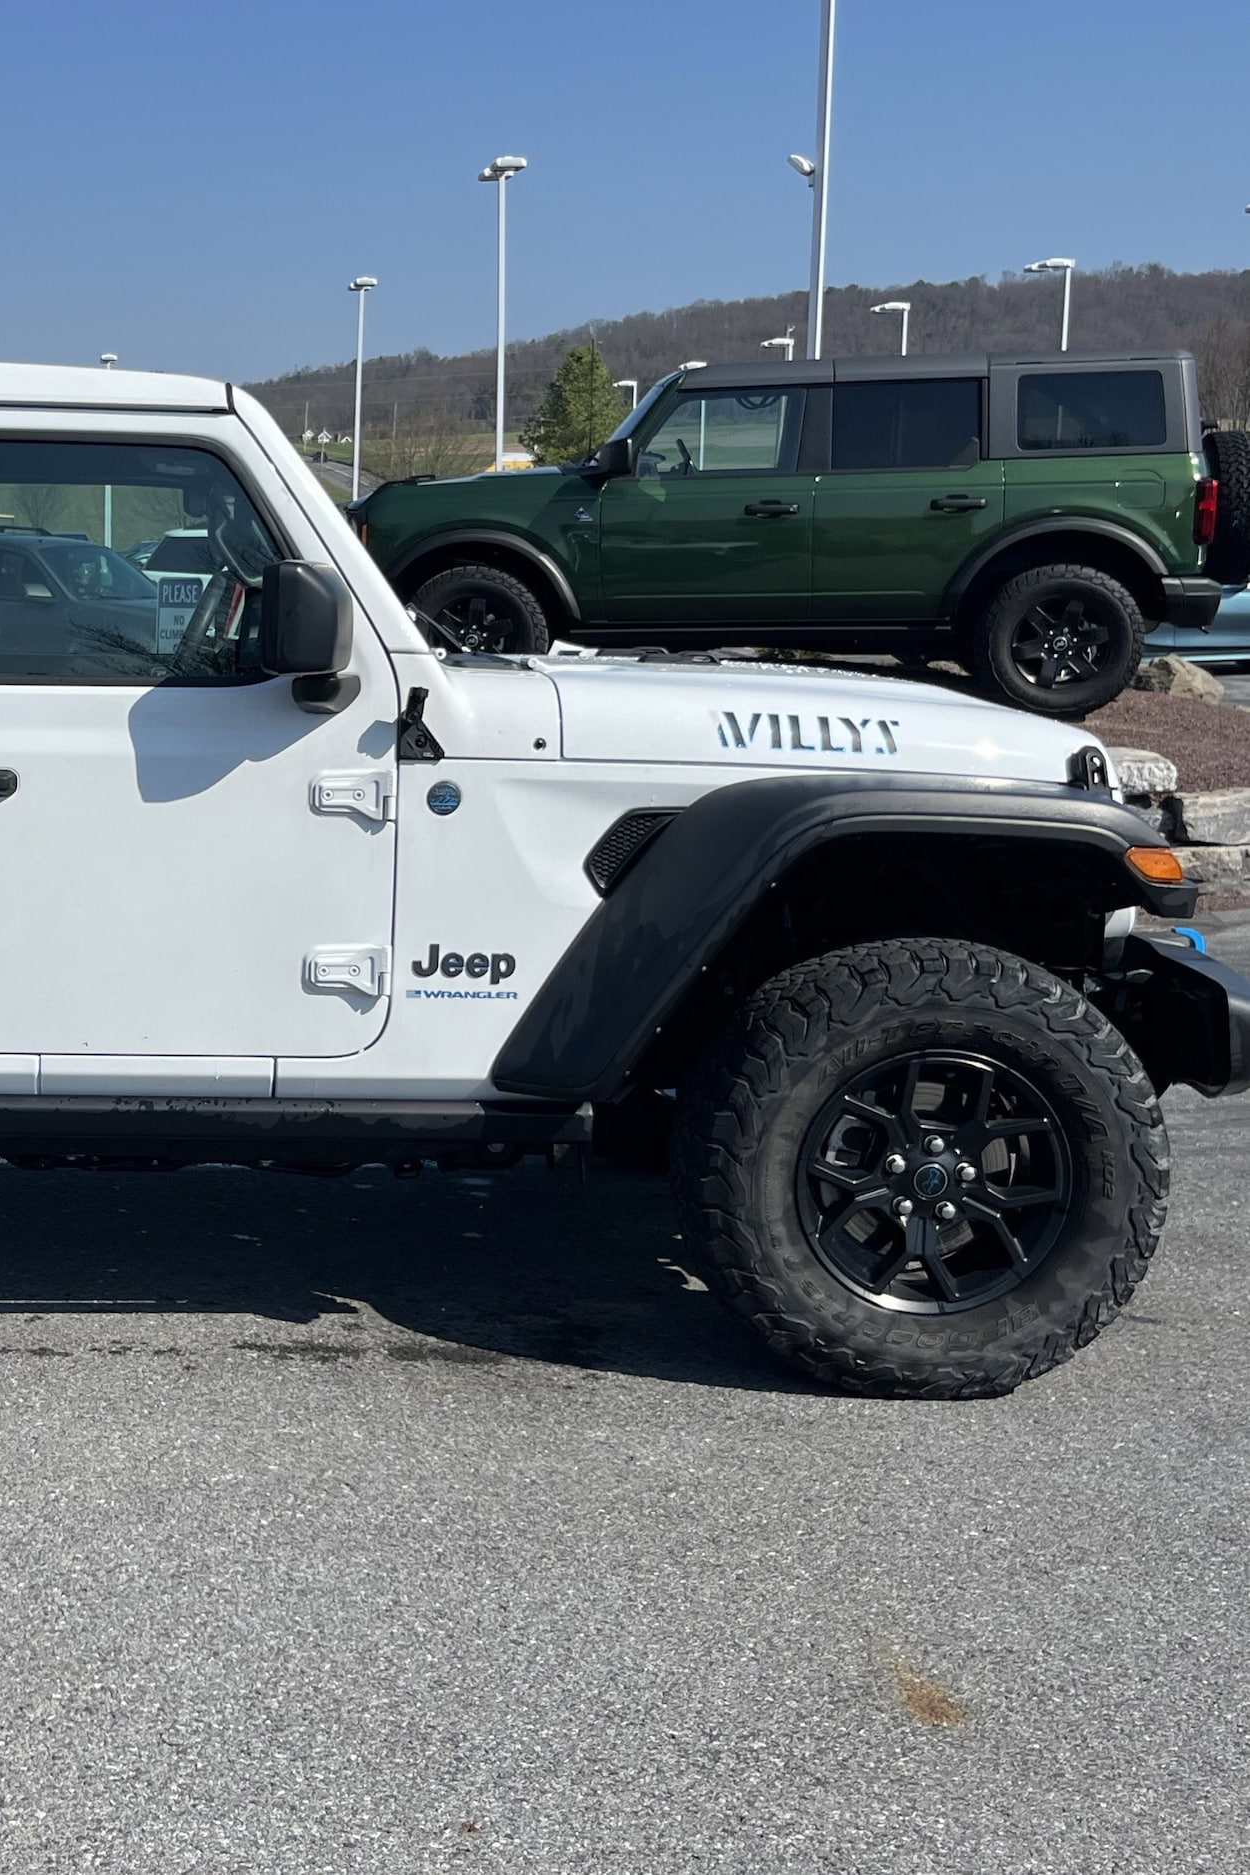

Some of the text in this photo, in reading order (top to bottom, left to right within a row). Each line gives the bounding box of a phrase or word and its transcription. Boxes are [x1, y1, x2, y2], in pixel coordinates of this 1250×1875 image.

[162, 584, 199, 604] PLEASE
[173, 614, 186, 626] NO
[708, 711, 900, 754] WILLYS
[411, 943, 516, 985] Jeep
[422, 989, 518, 999] WRANGLER
